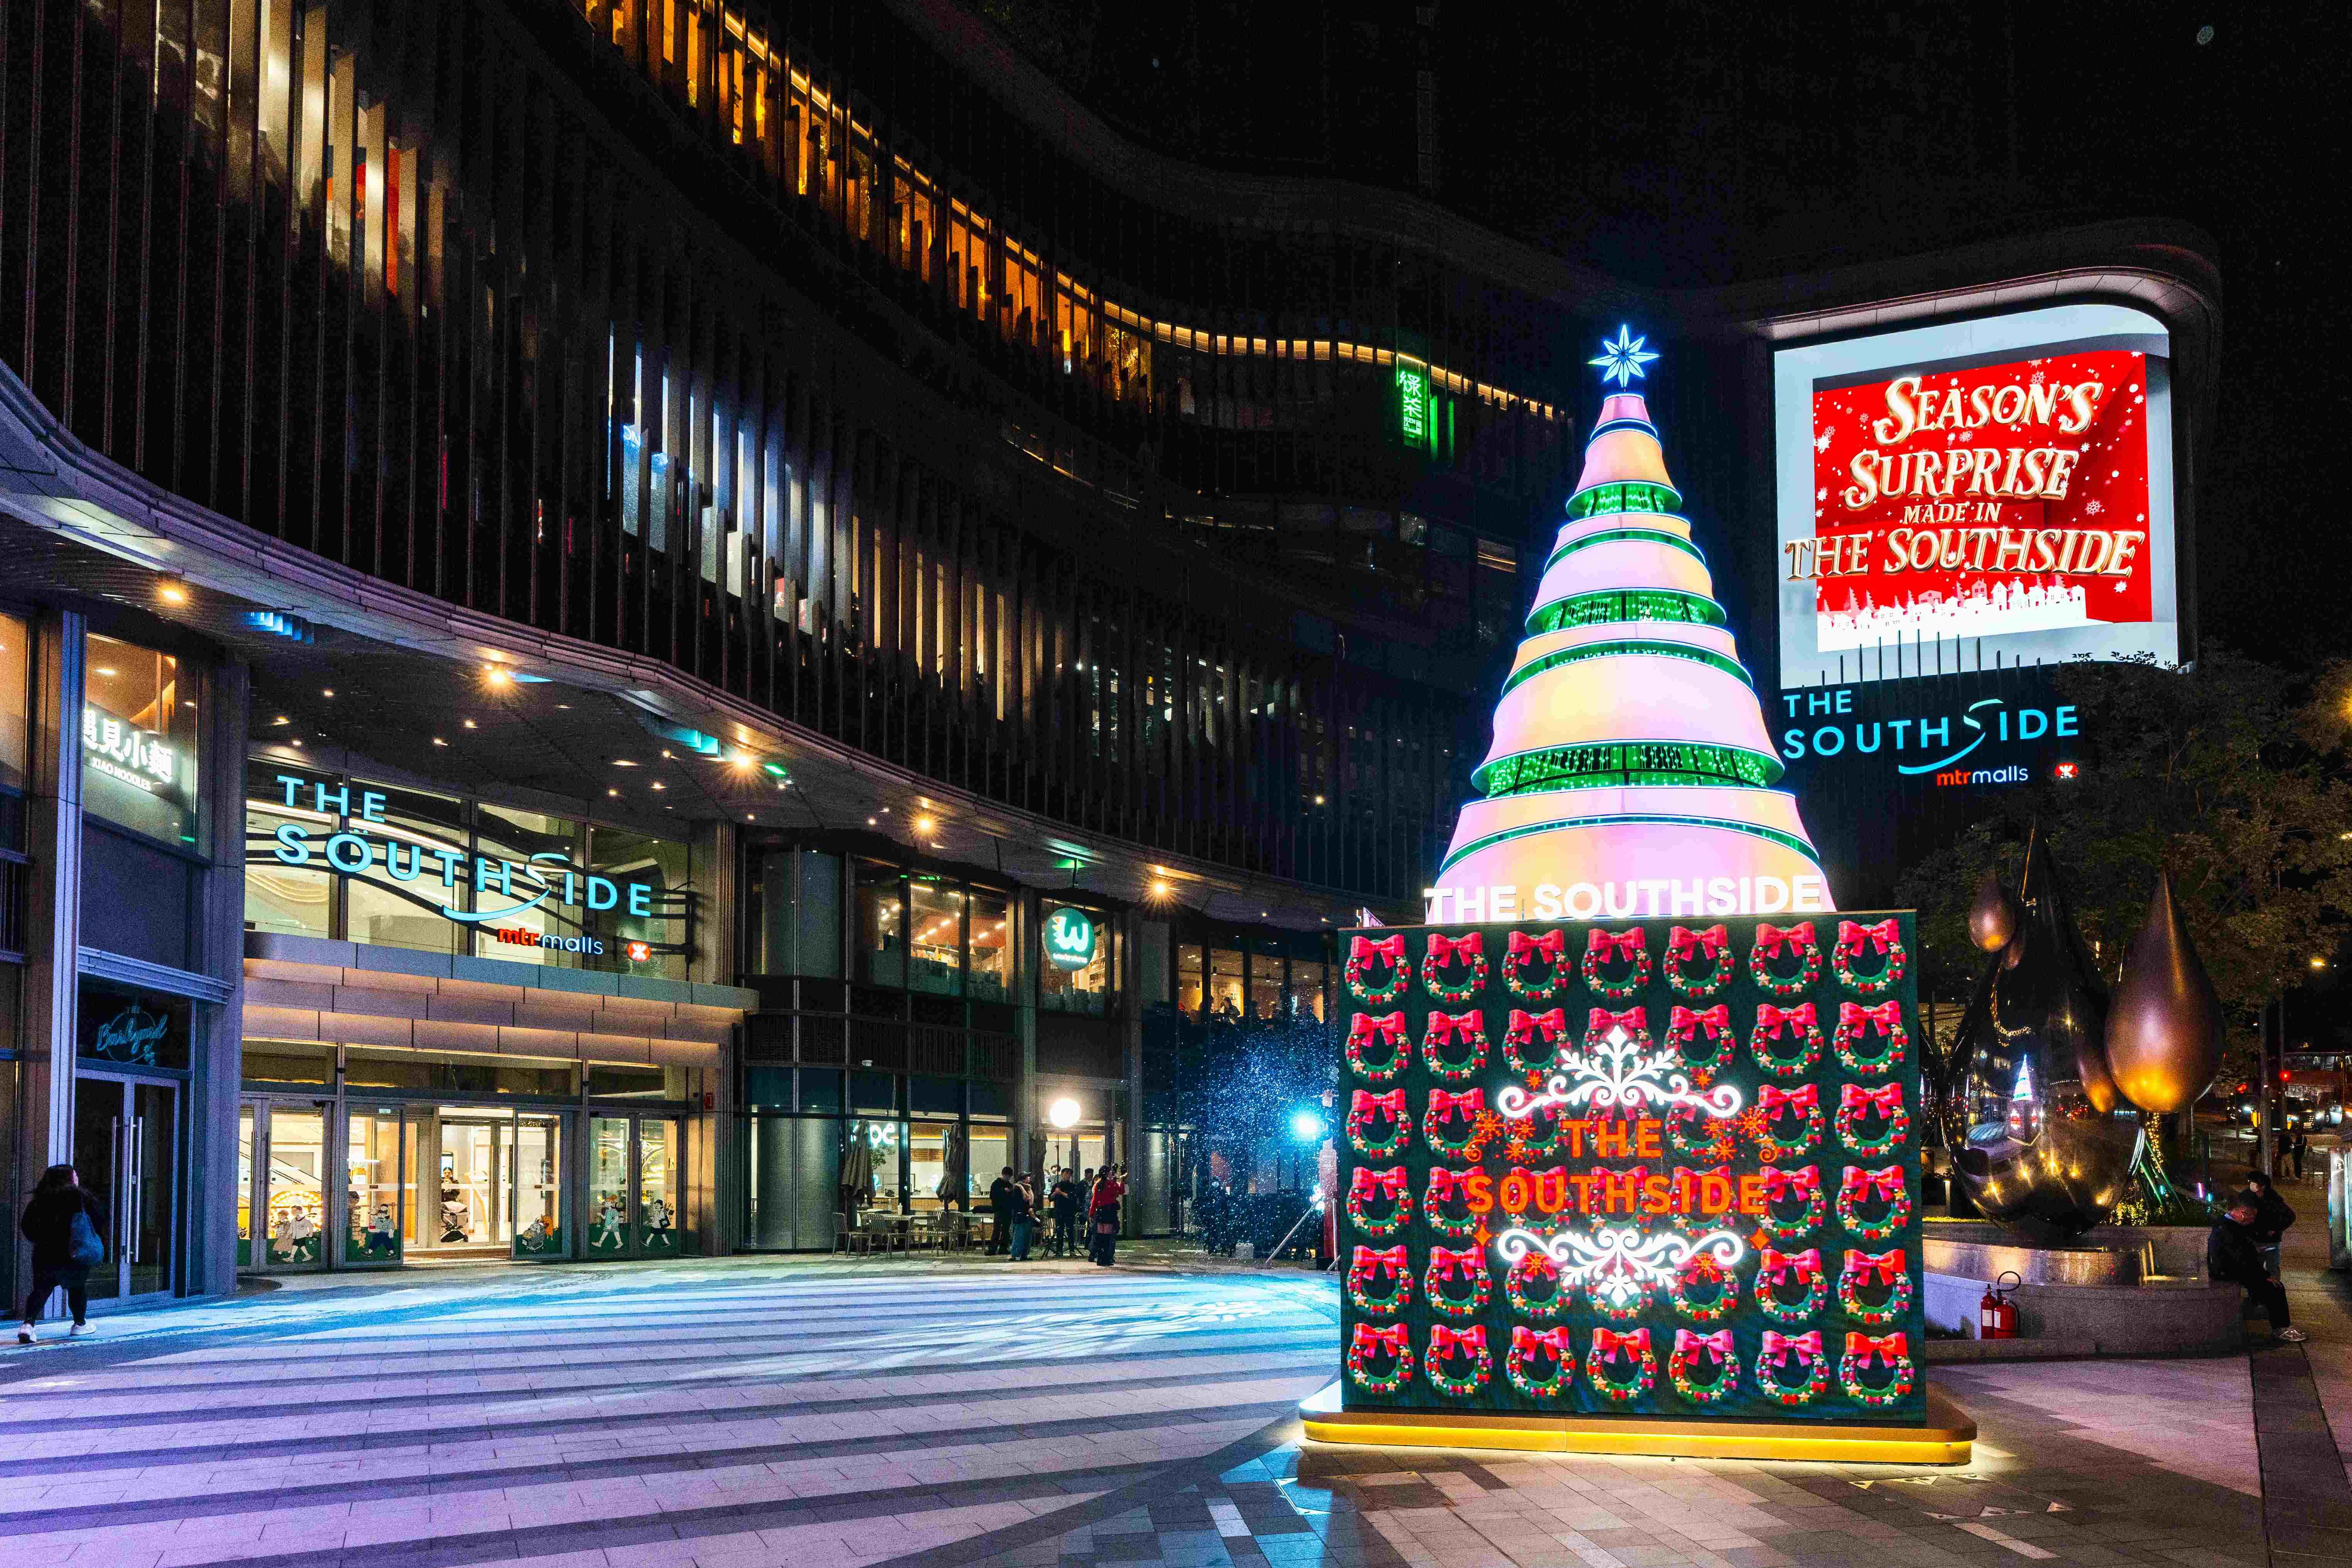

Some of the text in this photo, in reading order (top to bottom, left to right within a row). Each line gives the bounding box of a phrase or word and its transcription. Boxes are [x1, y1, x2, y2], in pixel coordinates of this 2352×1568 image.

[1873, 376, 2103, 446] SEASON'S
[1844, 448, 2079, 511] SURPRISE
[1902, 503, 2002, 524] MADE IN
[1785, 527, 2145, 581] THE SOUTHSIDE
[1783, 691, 1852, 717] THE
[1783, 699, 2078, 774] SOUTHSIDE
[92, 757, 151, 791] XIAO NOODLES
[277, 775, 386, 823] THE
[274, 824, 652, 921] SOUTHSIDE
[1423, 875, 1822, 924] THE SOUTHSIDE
[96, 1013, 168, 1054] Barkyard
[1560, 1119, 1663, 1158] THE
[1466, 1175, 1766, 1214] SOUTHSIDE
